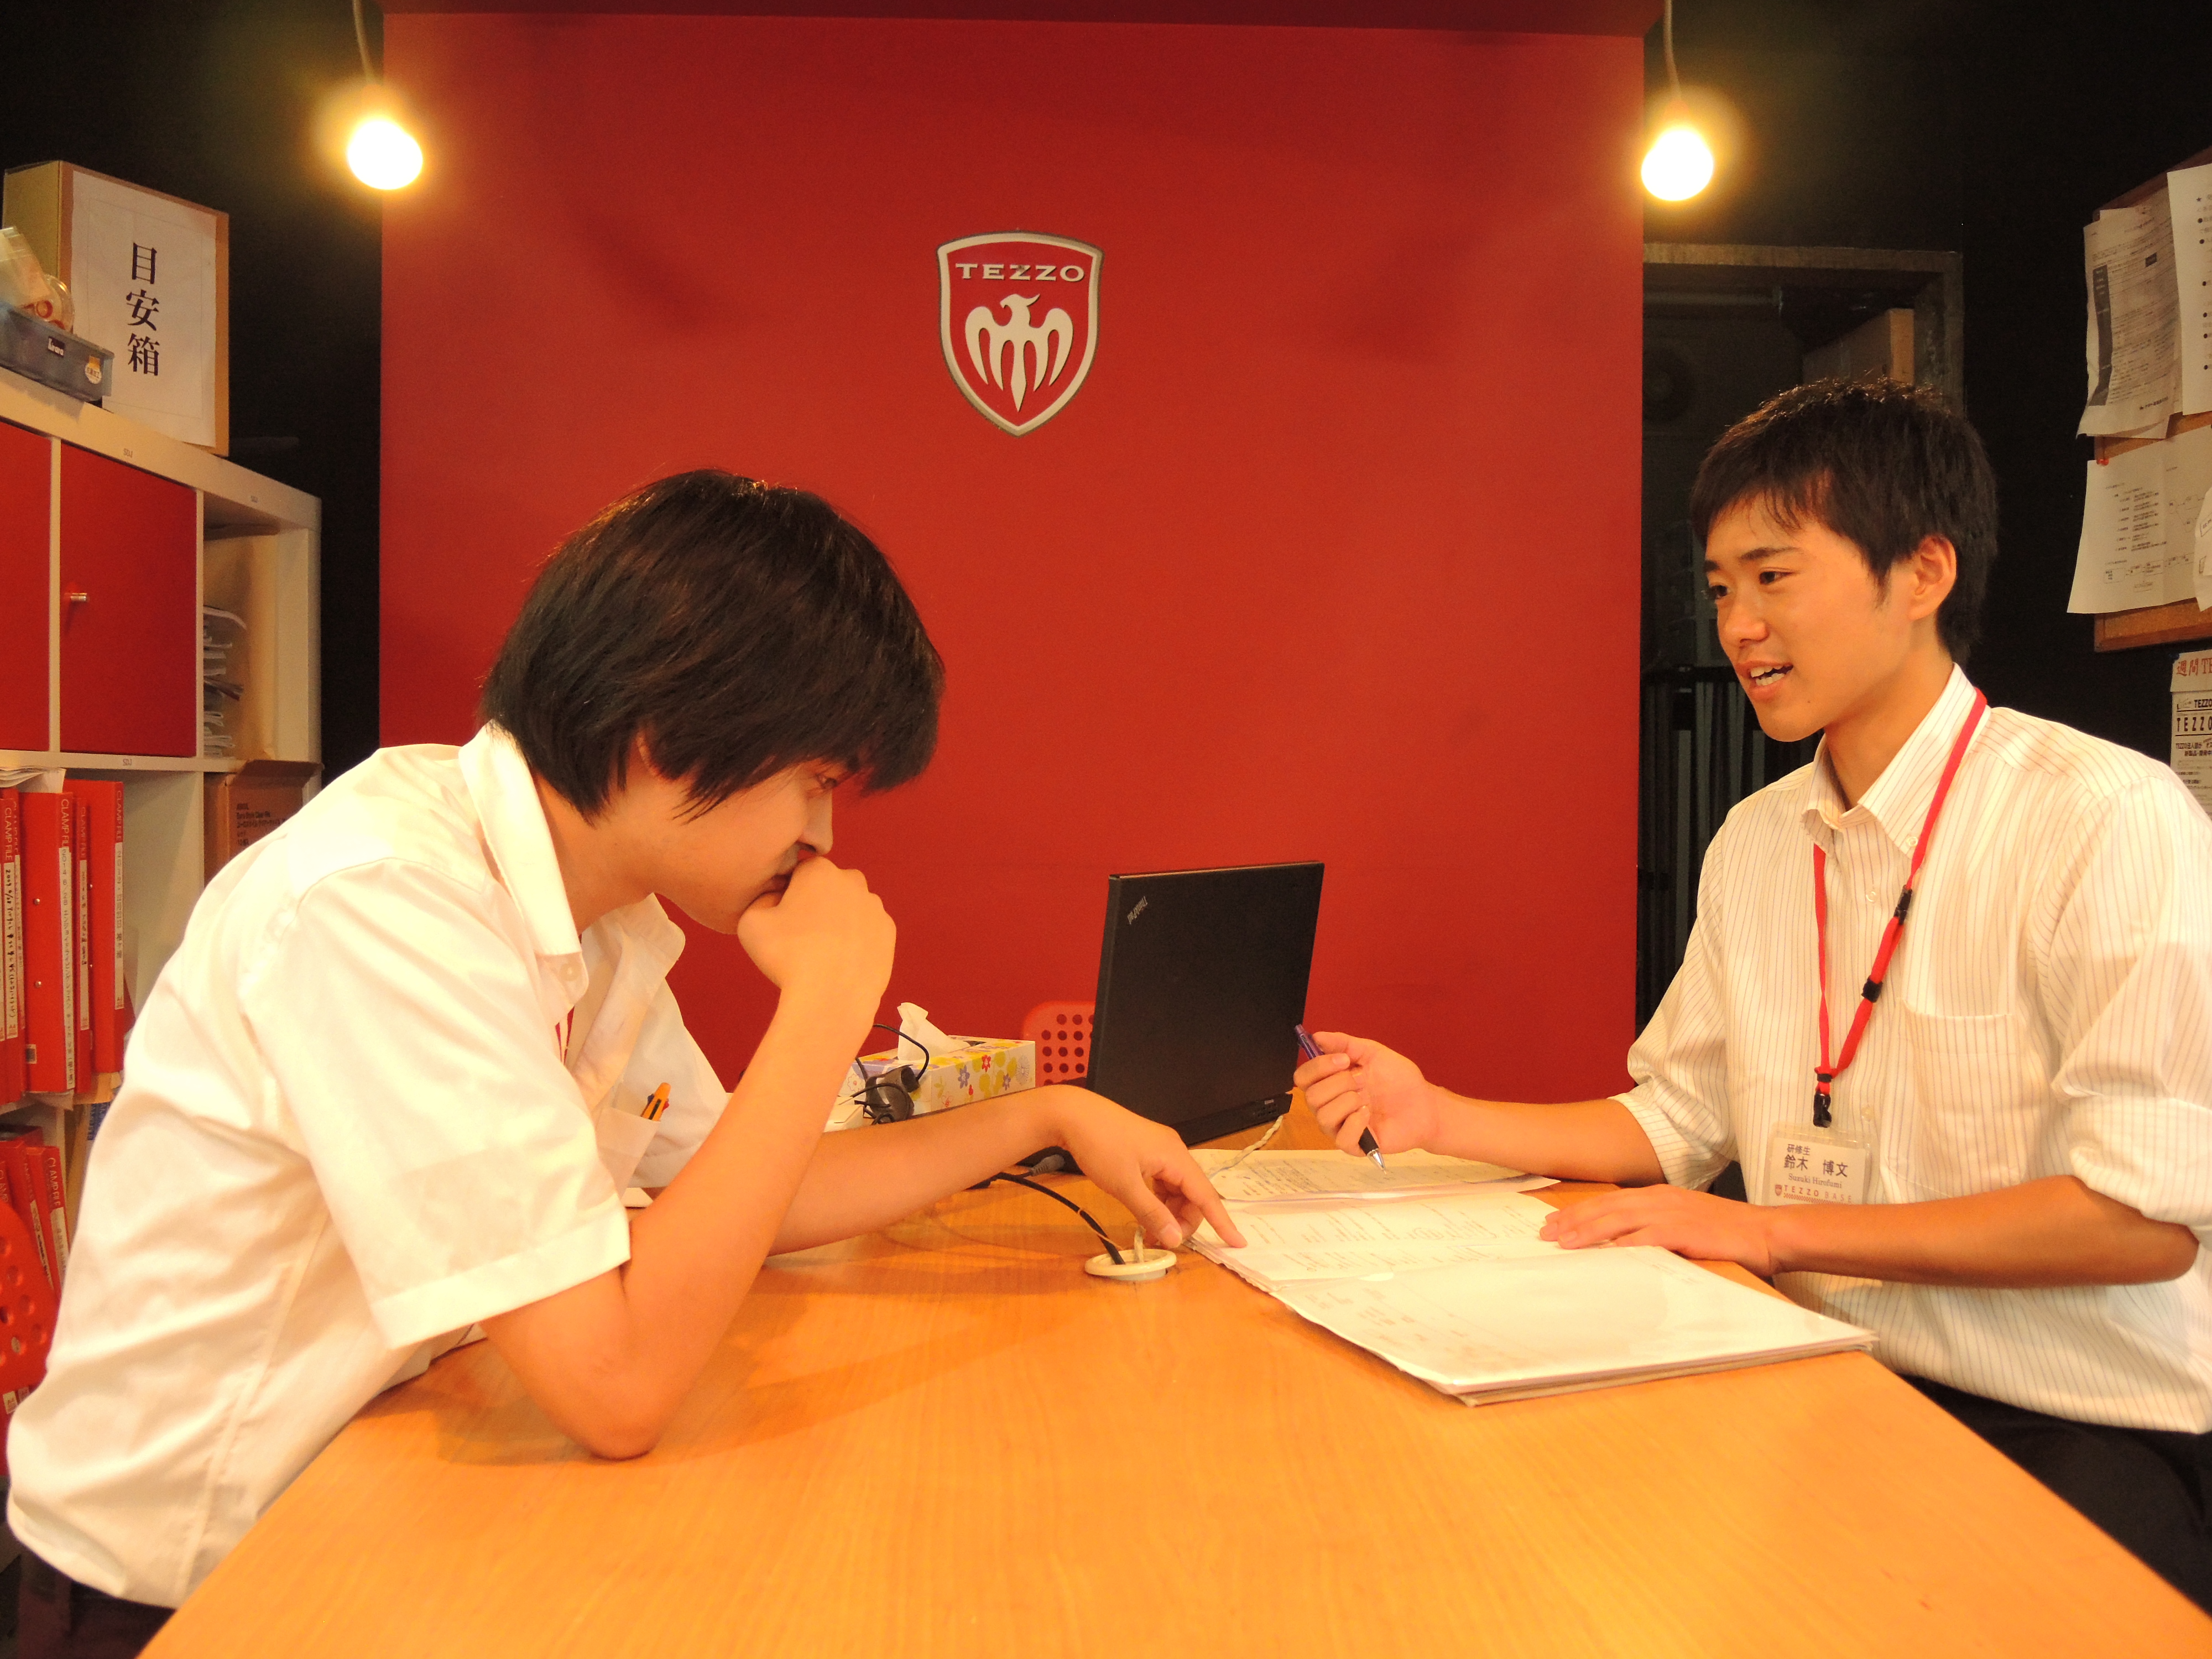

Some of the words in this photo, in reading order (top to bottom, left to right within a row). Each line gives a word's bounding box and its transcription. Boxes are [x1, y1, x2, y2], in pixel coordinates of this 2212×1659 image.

[955, 263, 1085, 283] TEZZO
[126, 242, 159, 376] 目安箱
[2177, 716, 2212, 732] TEZZO
[61, 799, 70, 834] CLAMP
[1787, 1144, 1811, 1156] 研修生
[48, 1157, 59, 1190] CLAMP
[1784, 1154, 1808, 1171] 鈴木
[1823, 1159, 1848, 1177] 博文
[1788, 1173, 1811, 1183] Suzuki
[1812, 1177, 1842, 1188] Hirofumi
[1784, 1185, 1819, 1197] TEZZO
[1825, 1191, 1851, 1203] BASE
